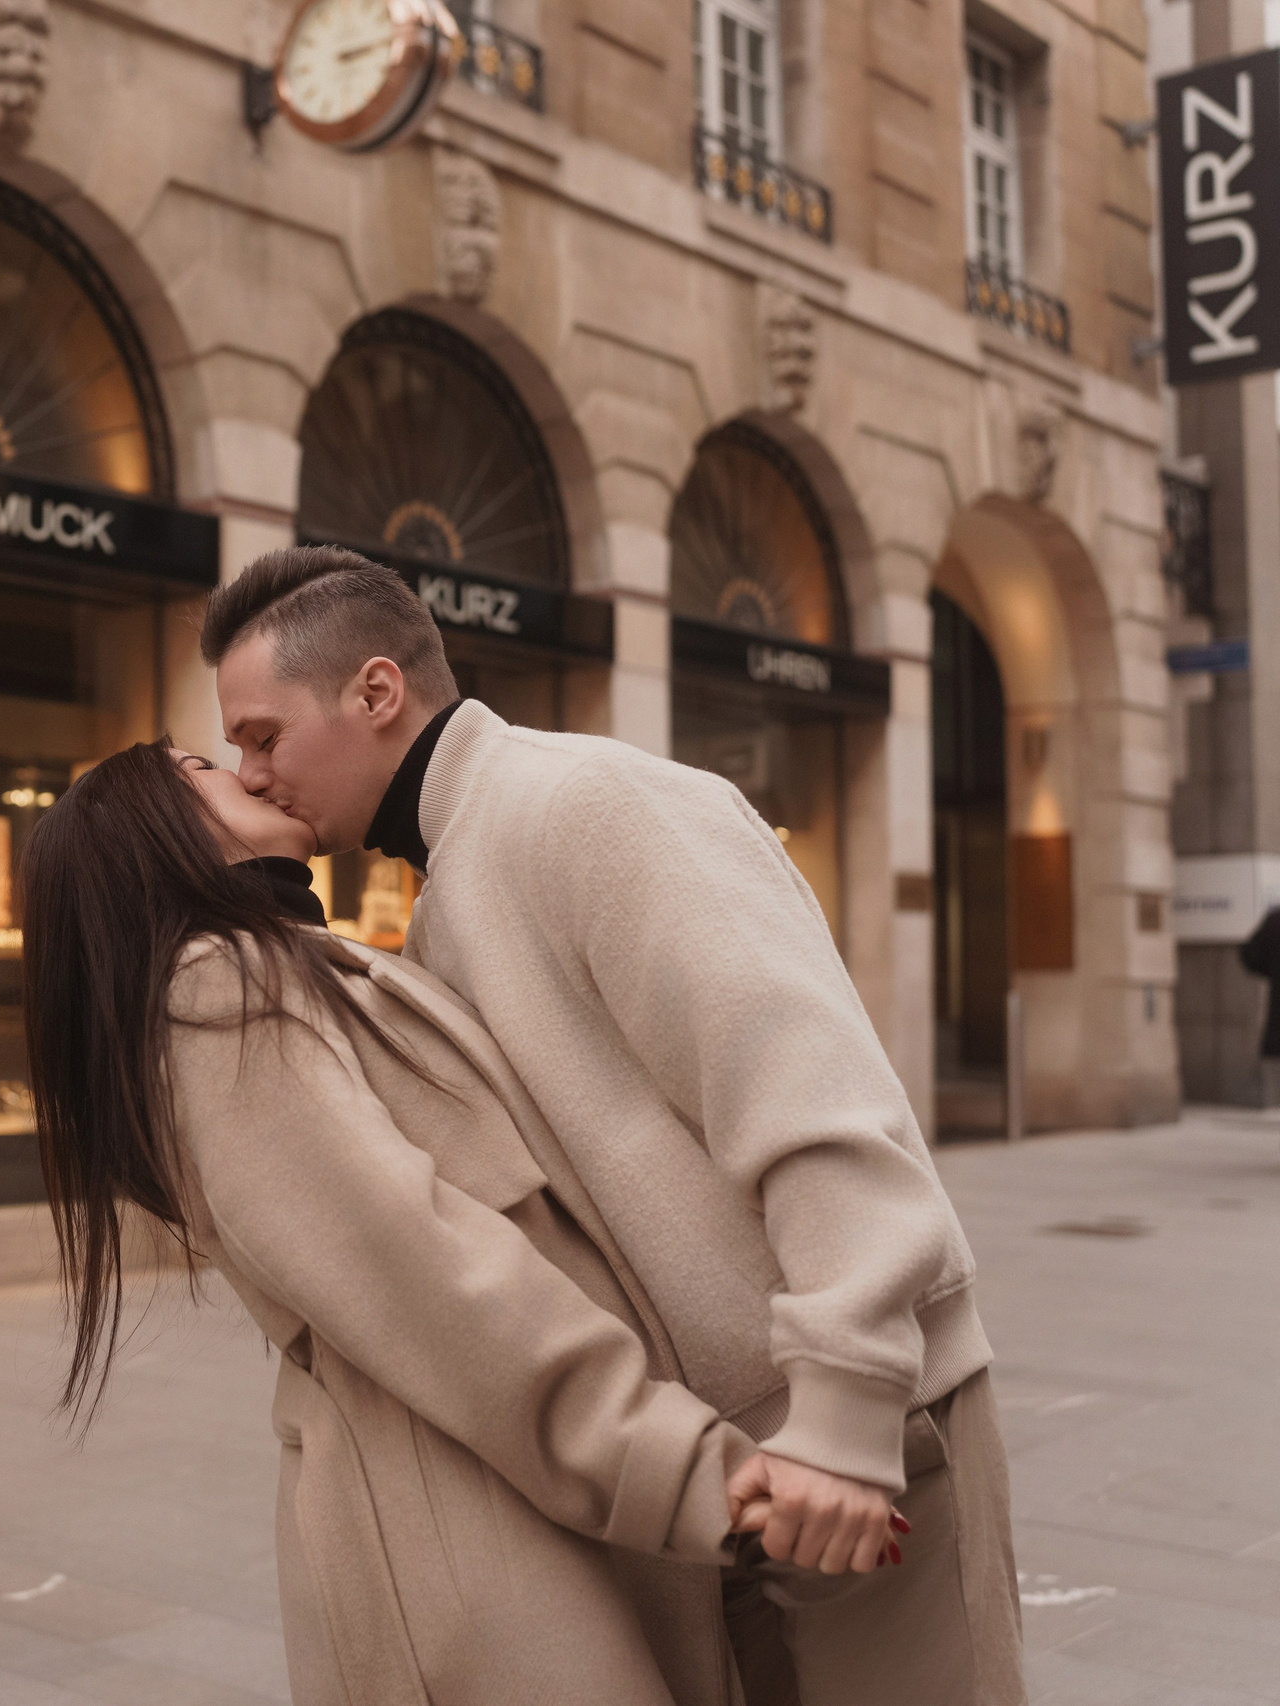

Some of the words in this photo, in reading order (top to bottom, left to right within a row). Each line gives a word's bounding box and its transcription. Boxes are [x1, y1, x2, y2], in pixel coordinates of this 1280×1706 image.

[1182, 71, 1258, 364] KURZ
[418, 574, 520, 634] KURZ
[747, 645, 831, 692] UHREN
